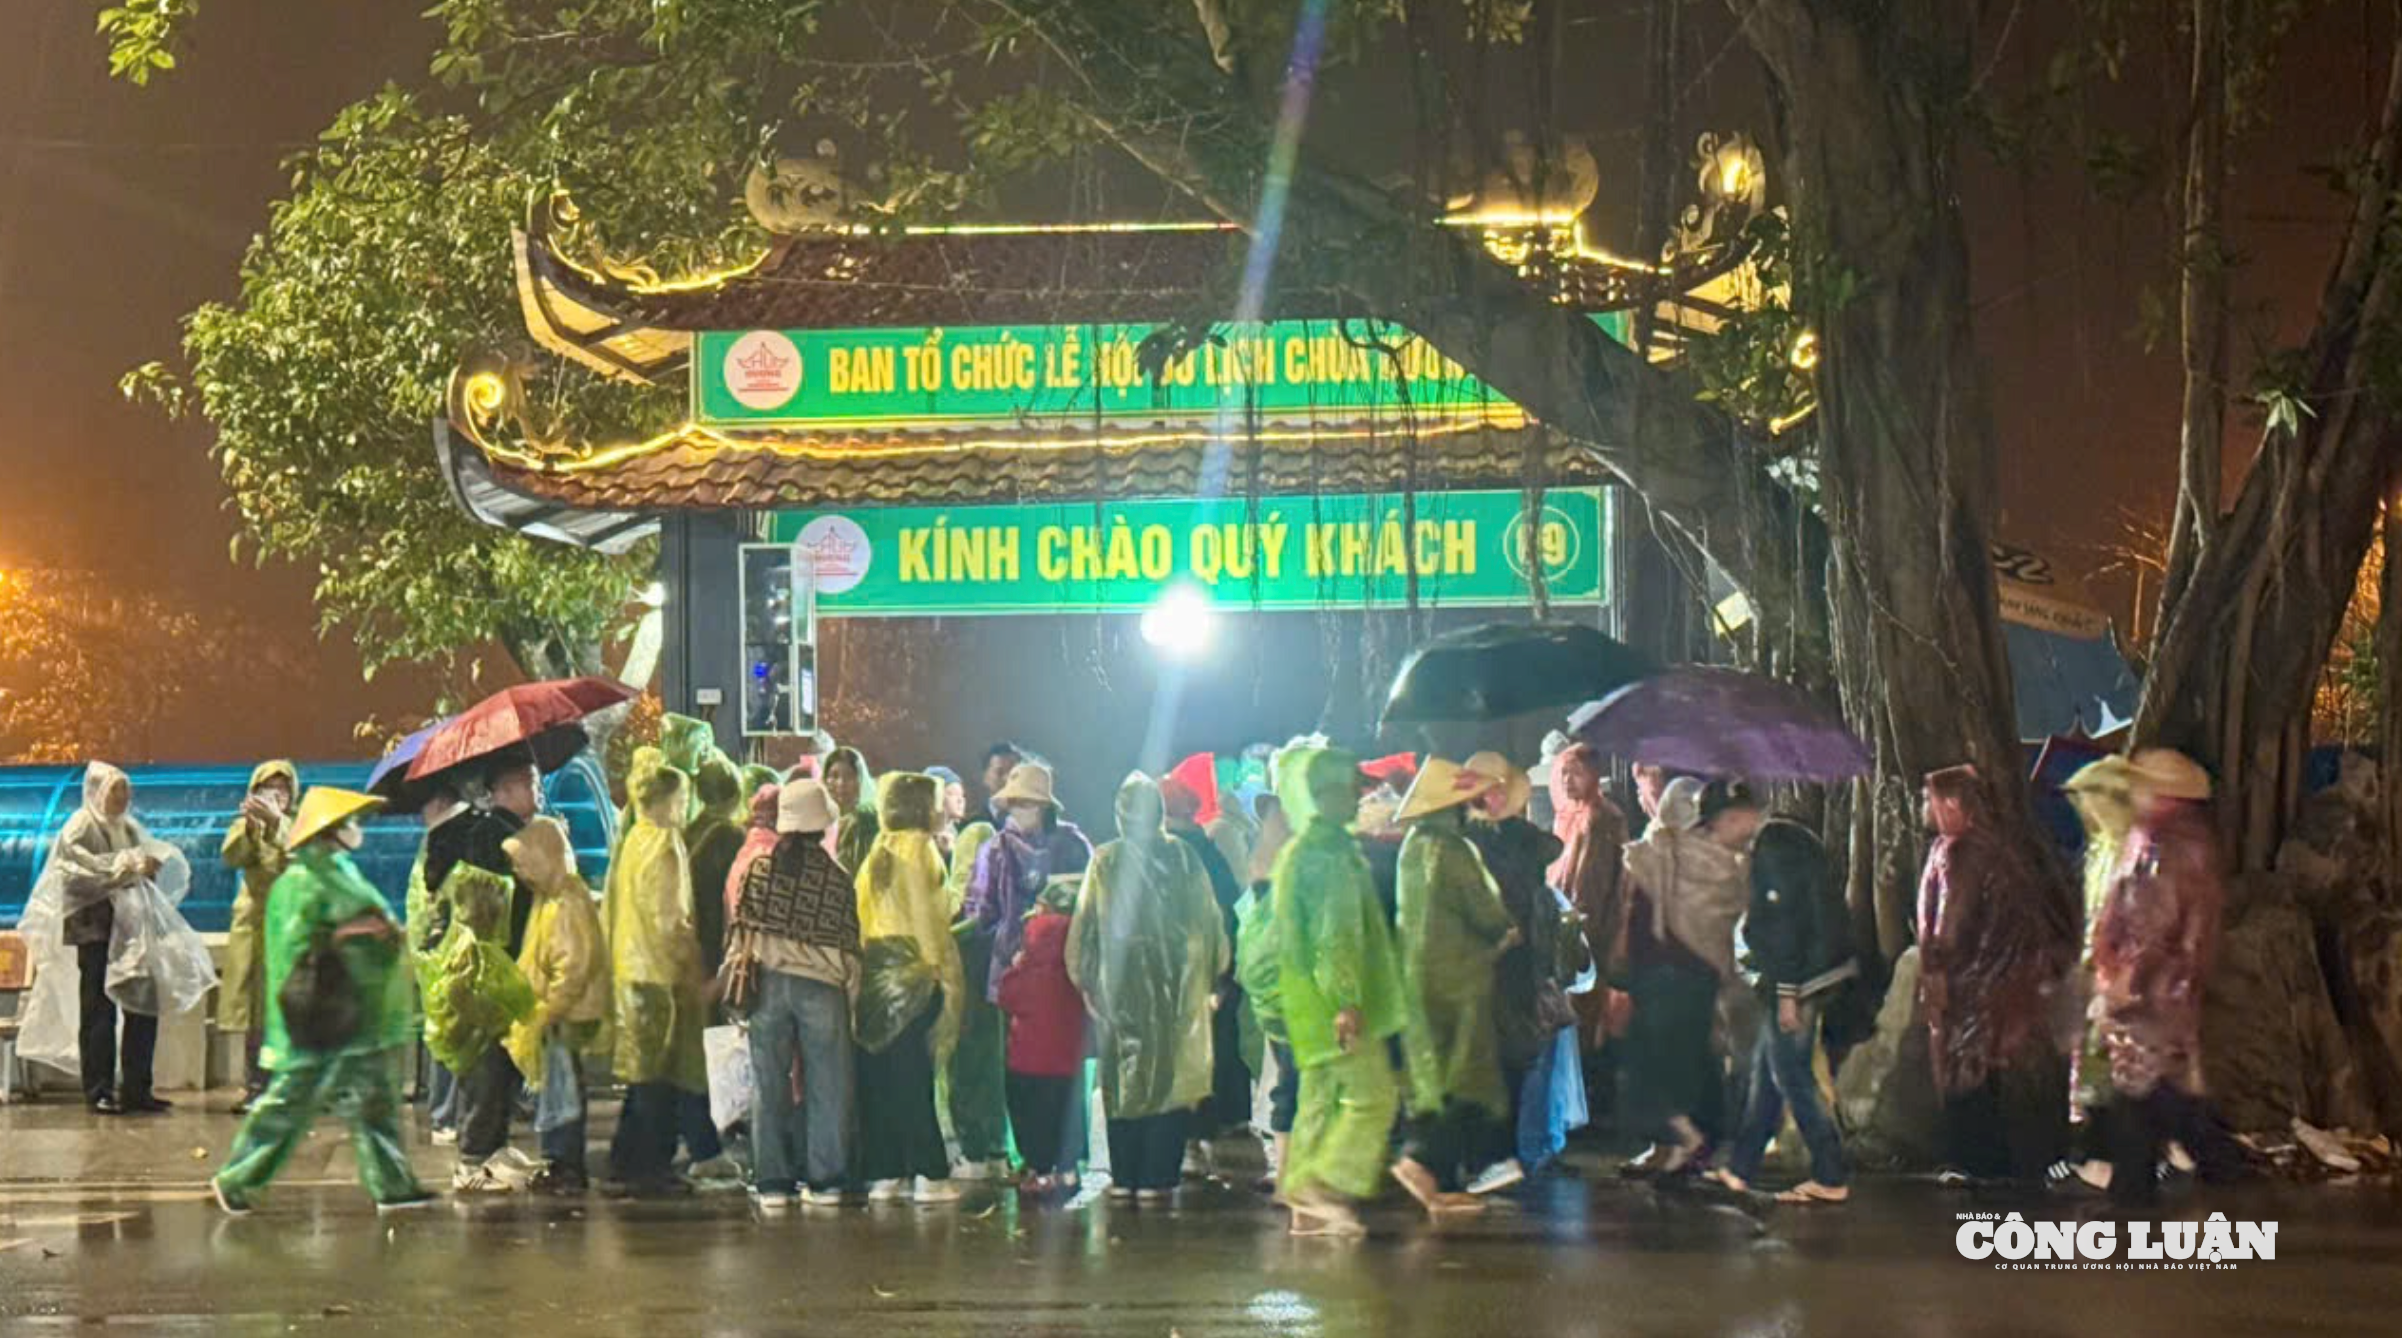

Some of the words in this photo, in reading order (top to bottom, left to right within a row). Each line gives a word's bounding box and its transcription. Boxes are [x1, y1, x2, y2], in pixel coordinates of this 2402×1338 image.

[829, 346, 895, 393] BAN
[903, 326, 943, 392] TỔ
[951, 329, 1036, 391] CHỨC
[1044, 324, 1082, 388] LỄ
[898, 515, 1020, 582] KÍNH
[1036, 514, 1173, 581] CHÀO
[1190, 511, 1288, 585] QUÝ
[1305, 508, 1477, 577] KHÁCH
